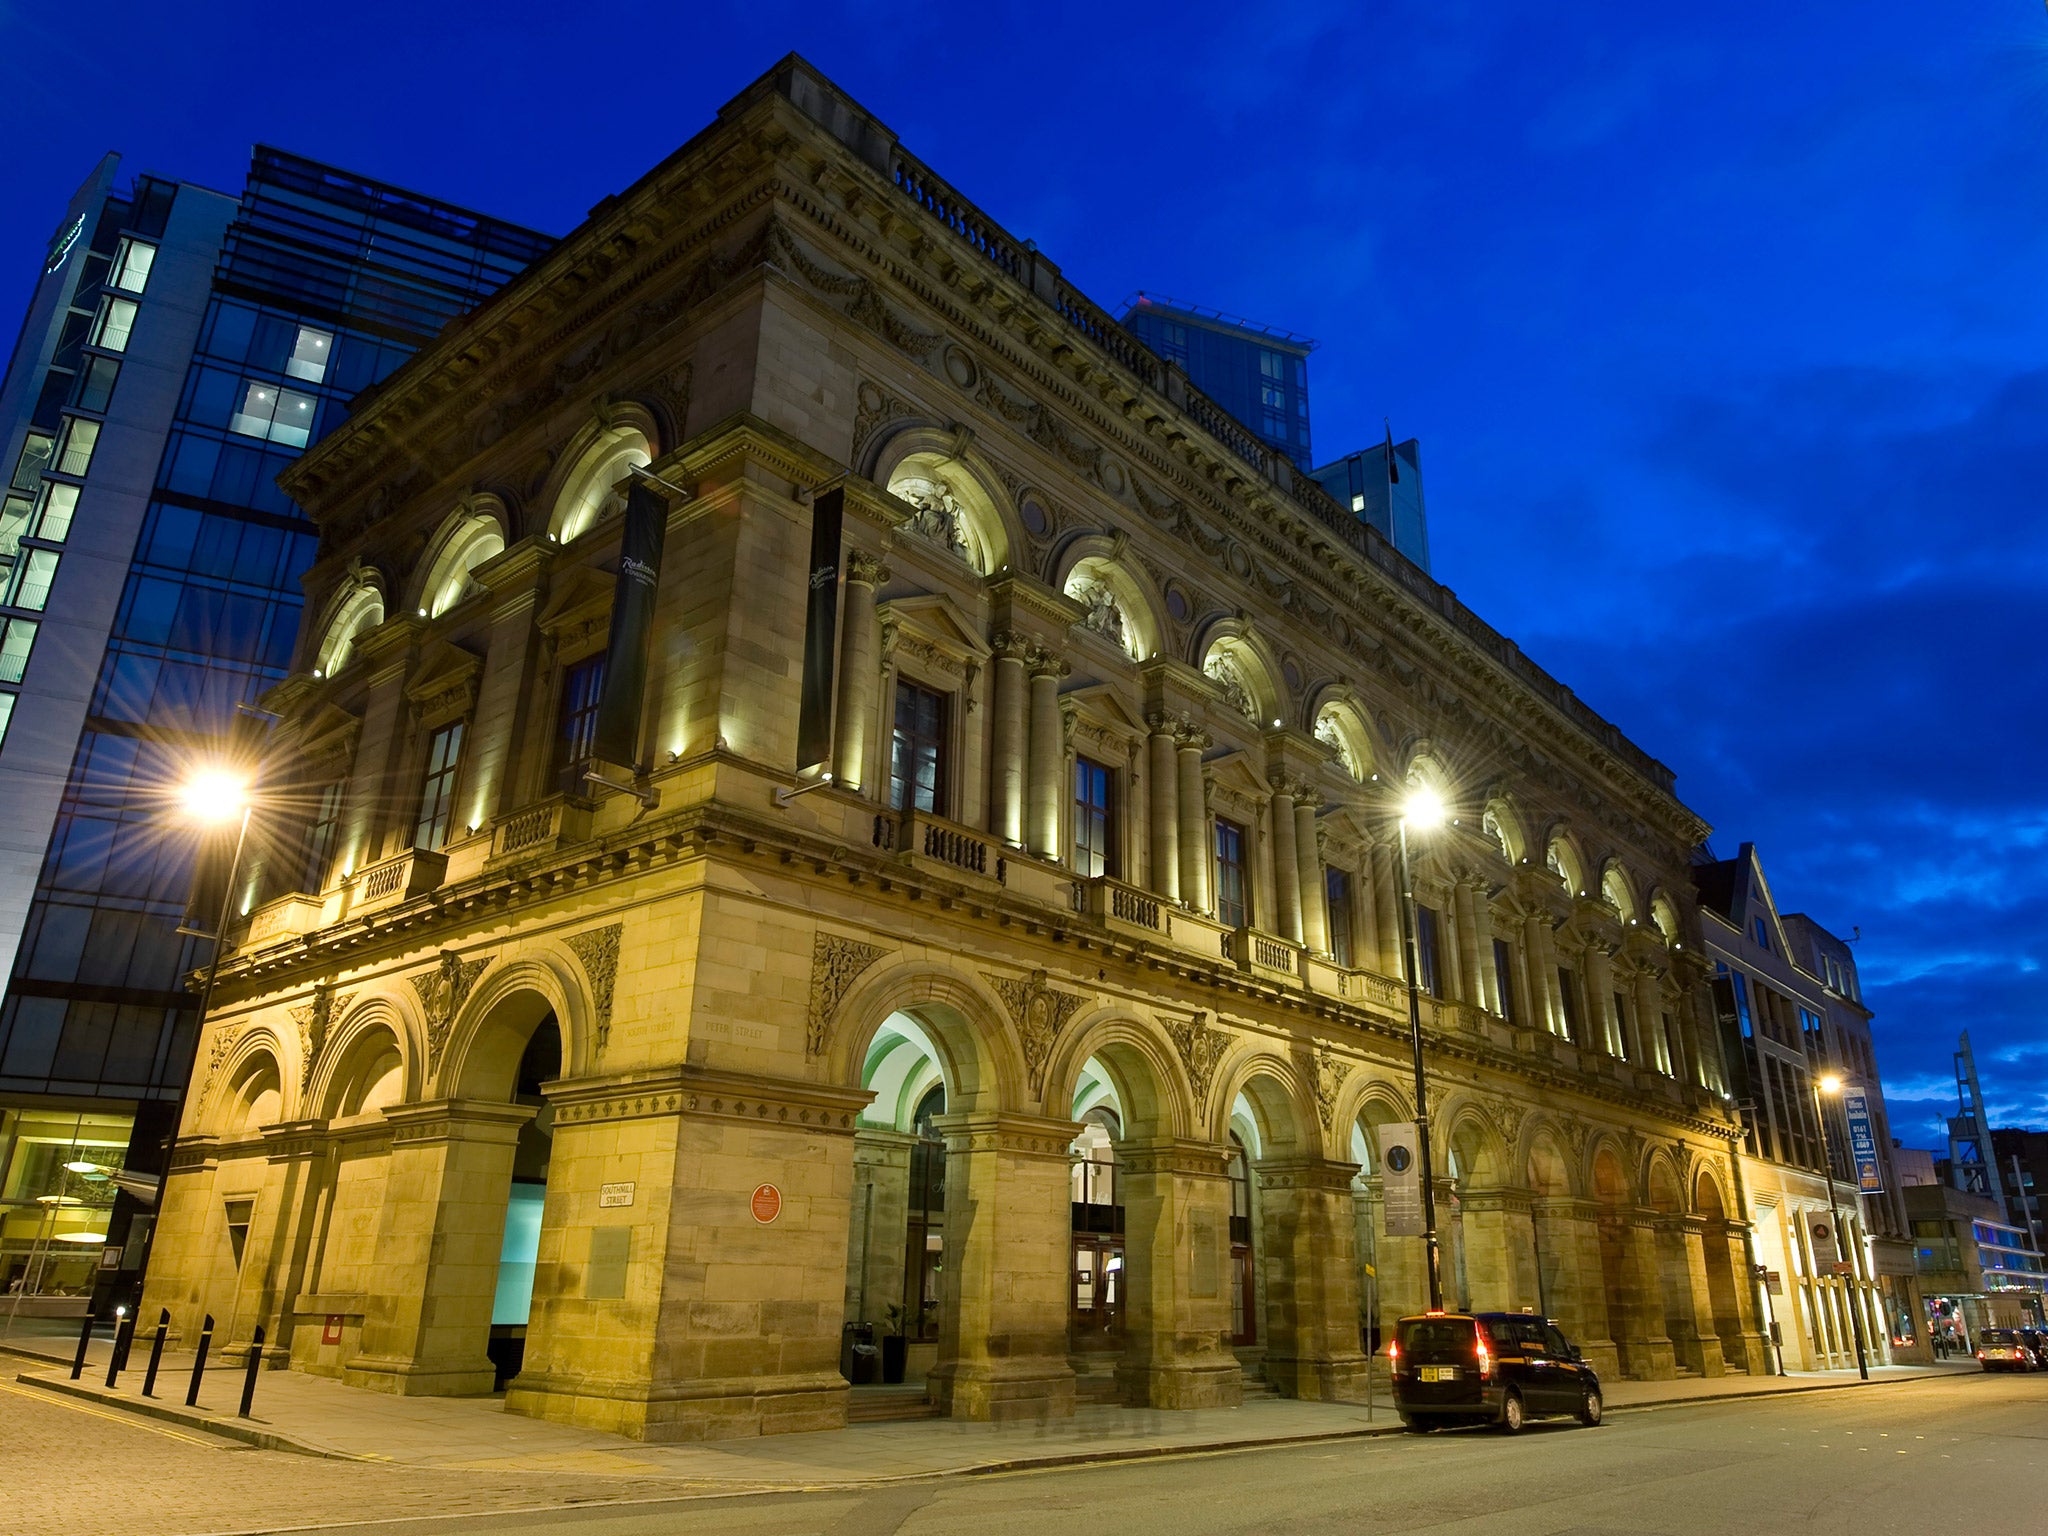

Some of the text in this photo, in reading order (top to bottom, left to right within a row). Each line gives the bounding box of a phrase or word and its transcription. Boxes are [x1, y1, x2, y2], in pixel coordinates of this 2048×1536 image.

[706, 1022, 763, 1039] PETER STREET
[602, 1185, 633, 1195] SOUTHMILL
[606, 1196, 627, 1204] STREET
